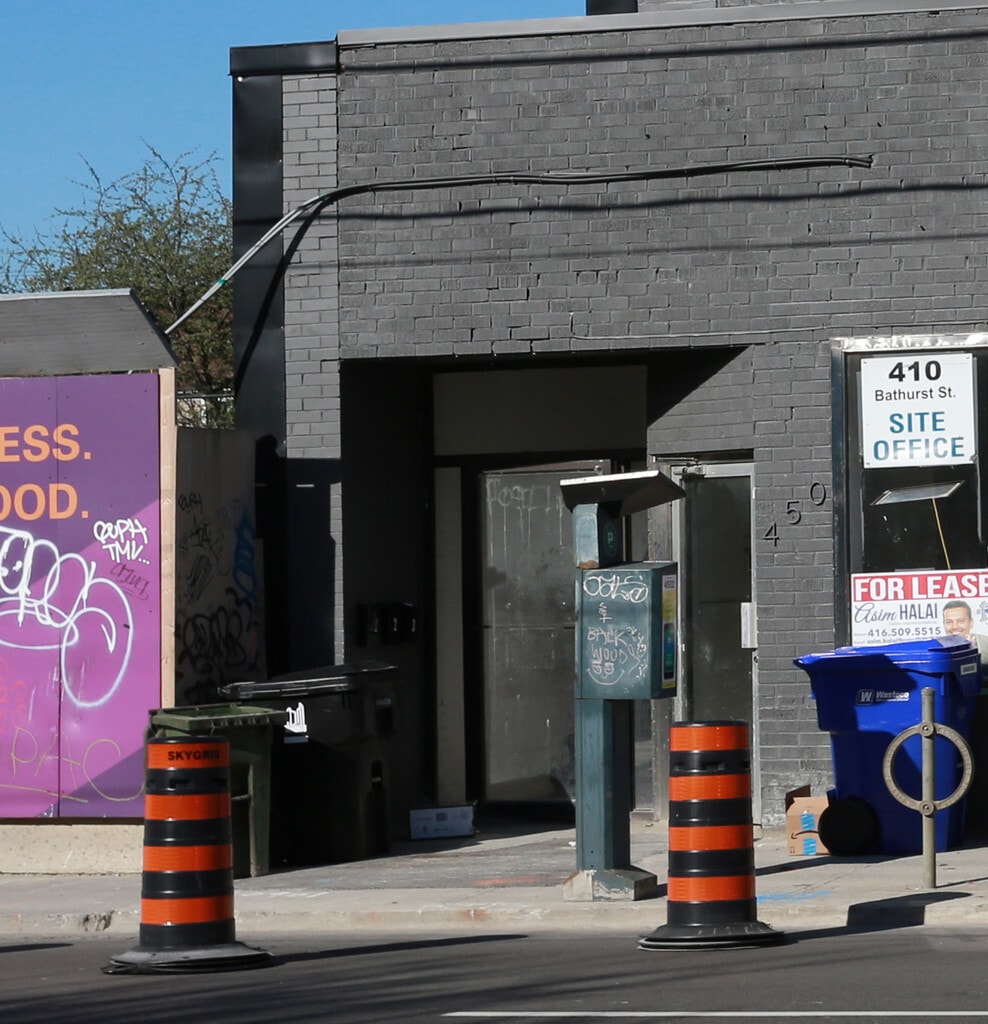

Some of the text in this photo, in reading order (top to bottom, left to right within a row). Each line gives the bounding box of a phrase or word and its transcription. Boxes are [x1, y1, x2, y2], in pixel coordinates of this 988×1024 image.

[888, 361, 942, 382] 410
[874, 386, 957, 402] Bathurst St.
[889, 411, 946, 434] SITE
[873, 437, 965, 461] OFFICE
[855, 577, 904, 600] FOR
[855, 602, 938, 623] Asim HALAI
[867, 626, 942, 637] 416.509.5515
